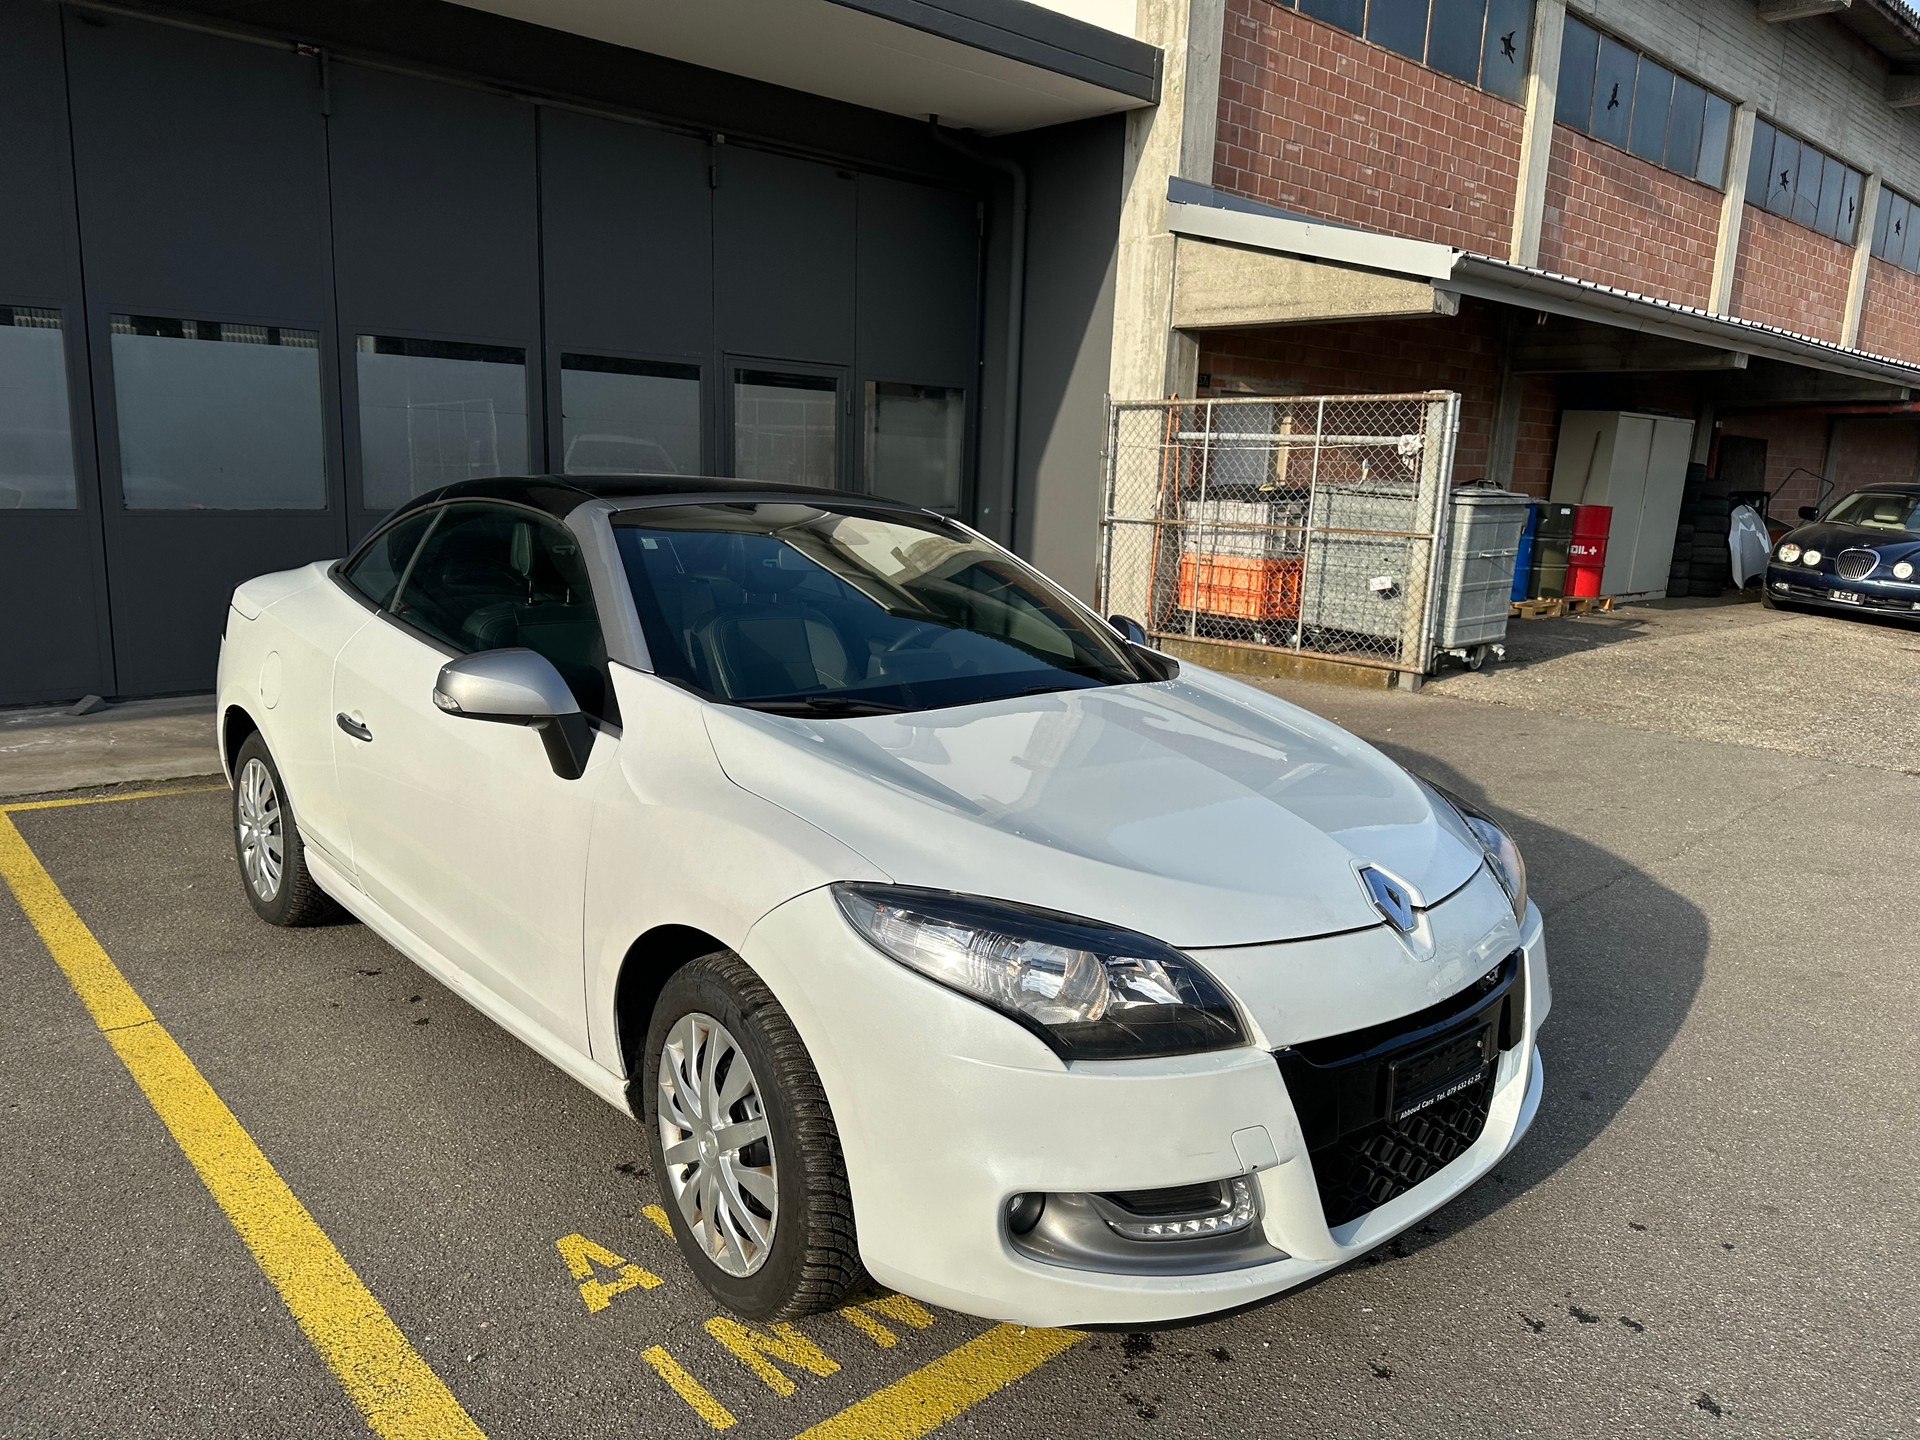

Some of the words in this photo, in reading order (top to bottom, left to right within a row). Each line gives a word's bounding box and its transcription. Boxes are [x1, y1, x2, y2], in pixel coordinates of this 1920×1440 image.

[1421, 1098, 1434, 1108] Cars
[1446, 1086, 1457, 1096] 079
[1475, 1073, 1481, 1081] 25
